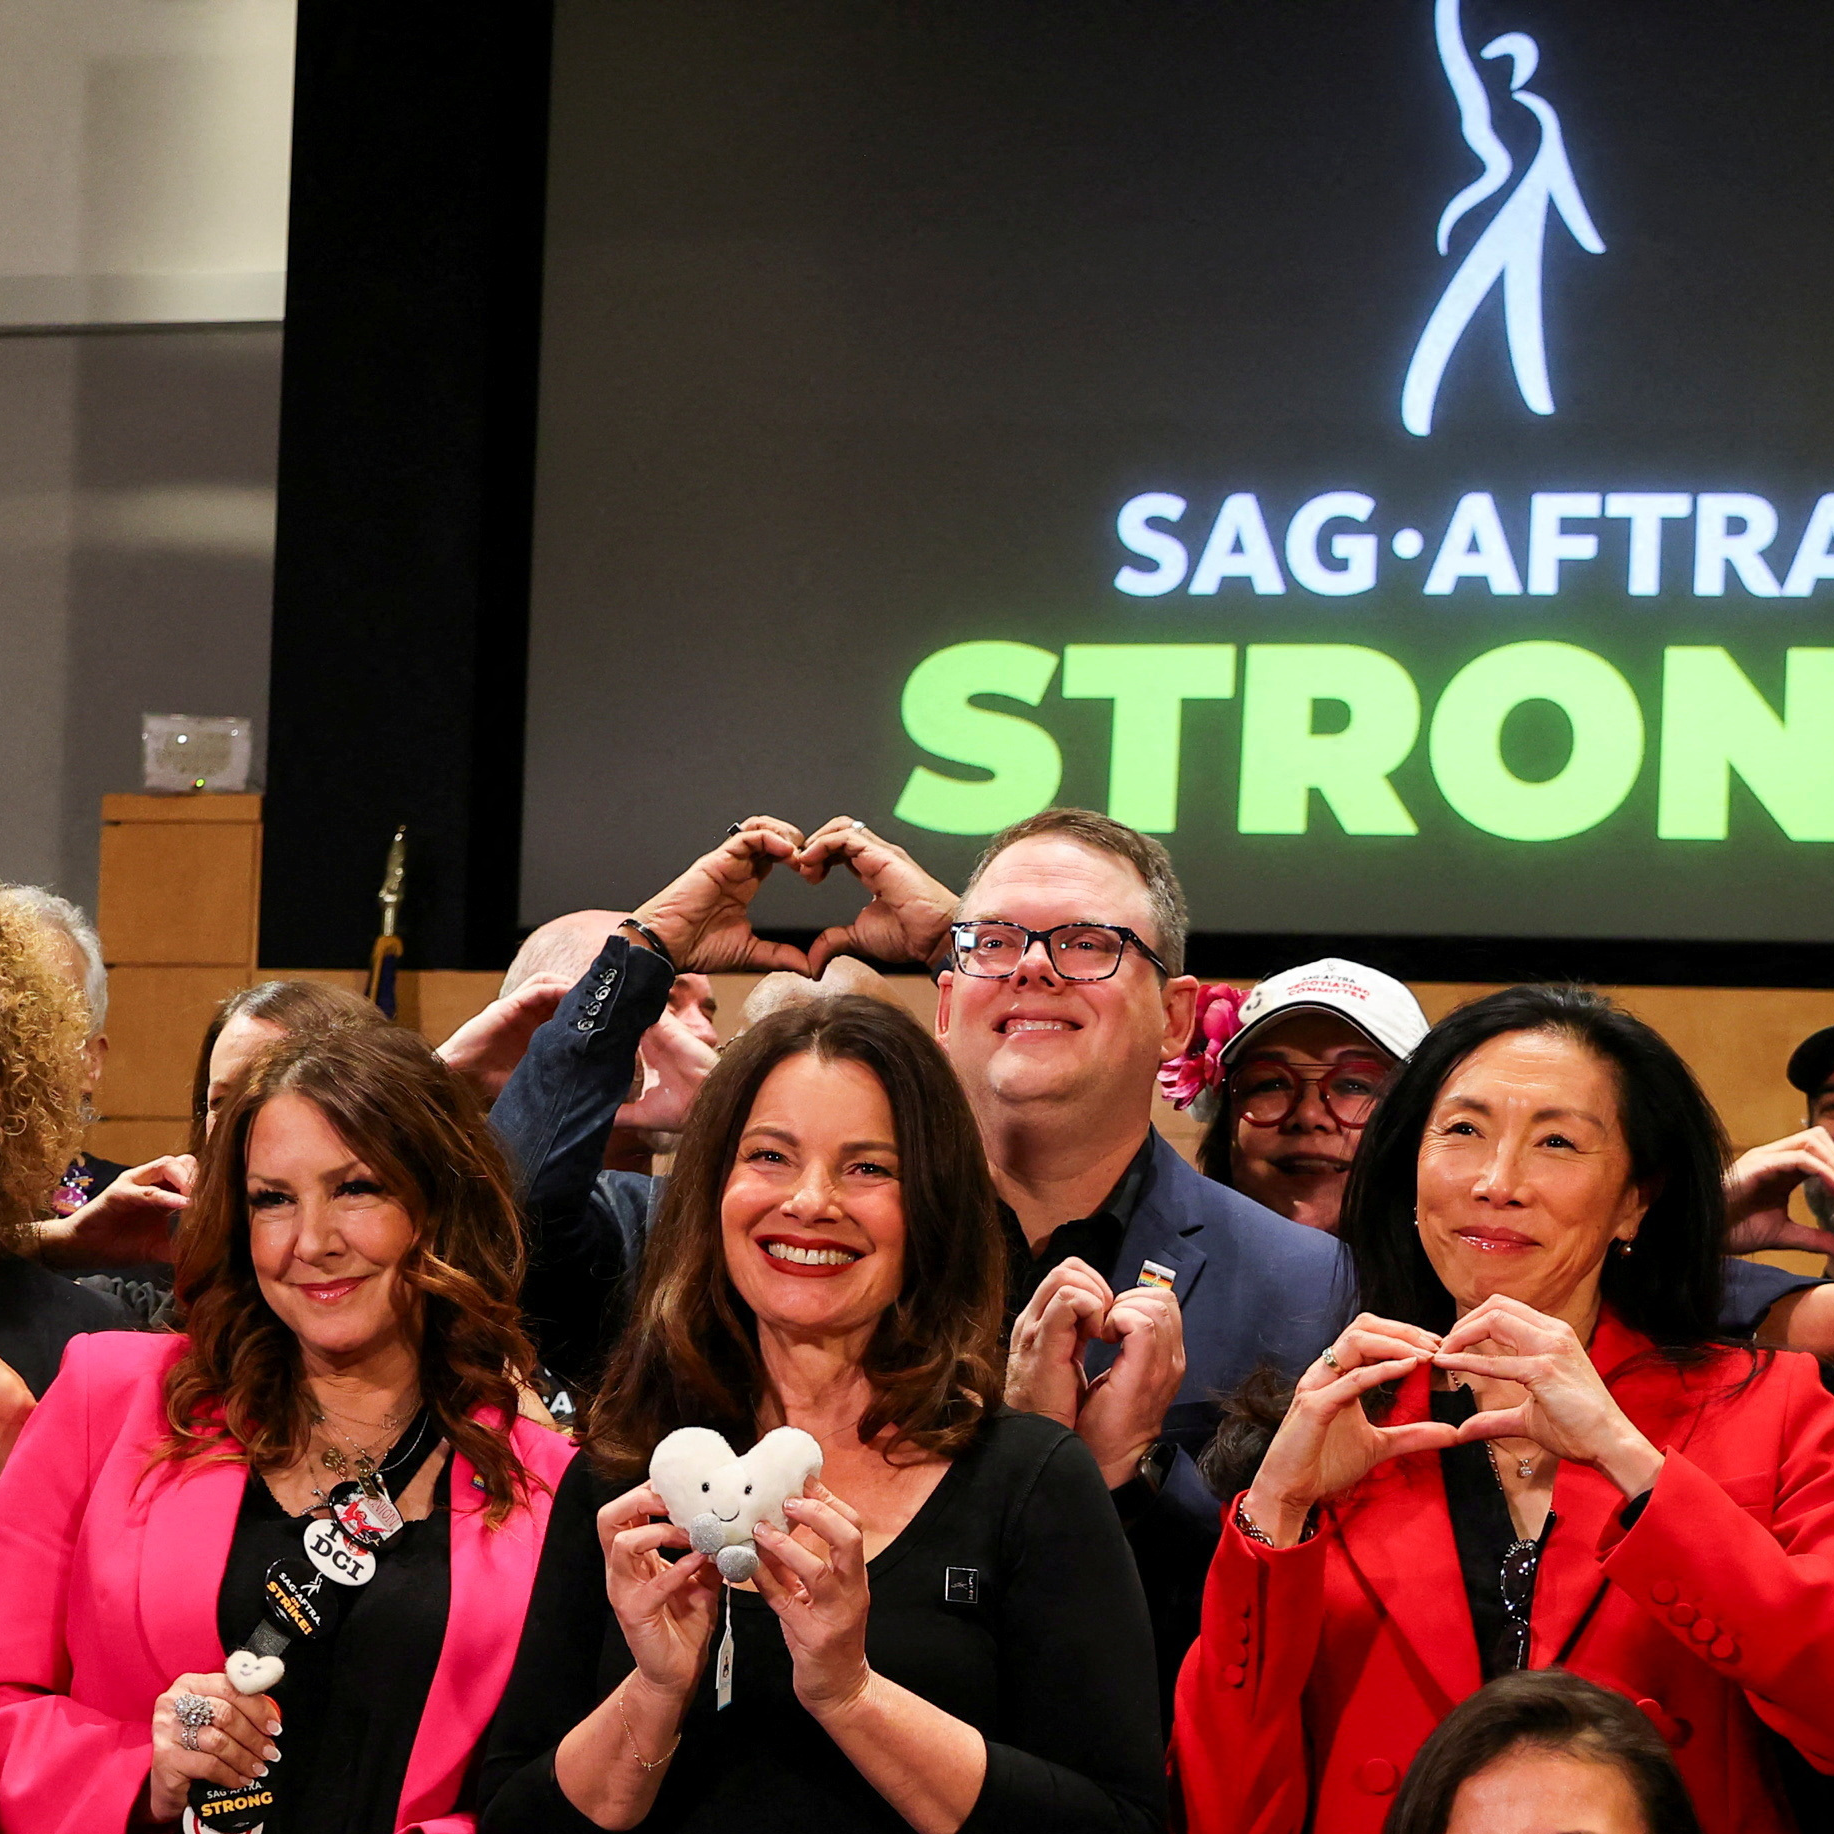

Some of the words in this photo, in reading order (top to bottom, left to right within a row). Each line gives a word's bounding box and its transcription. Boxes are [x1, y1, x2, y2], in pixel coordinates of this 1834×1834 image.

[310, 1534, 365, 1581] DCI
[266, 1580, 313, 1636] STRIKE!
[200, 1791, 274, 1817] STRONG
